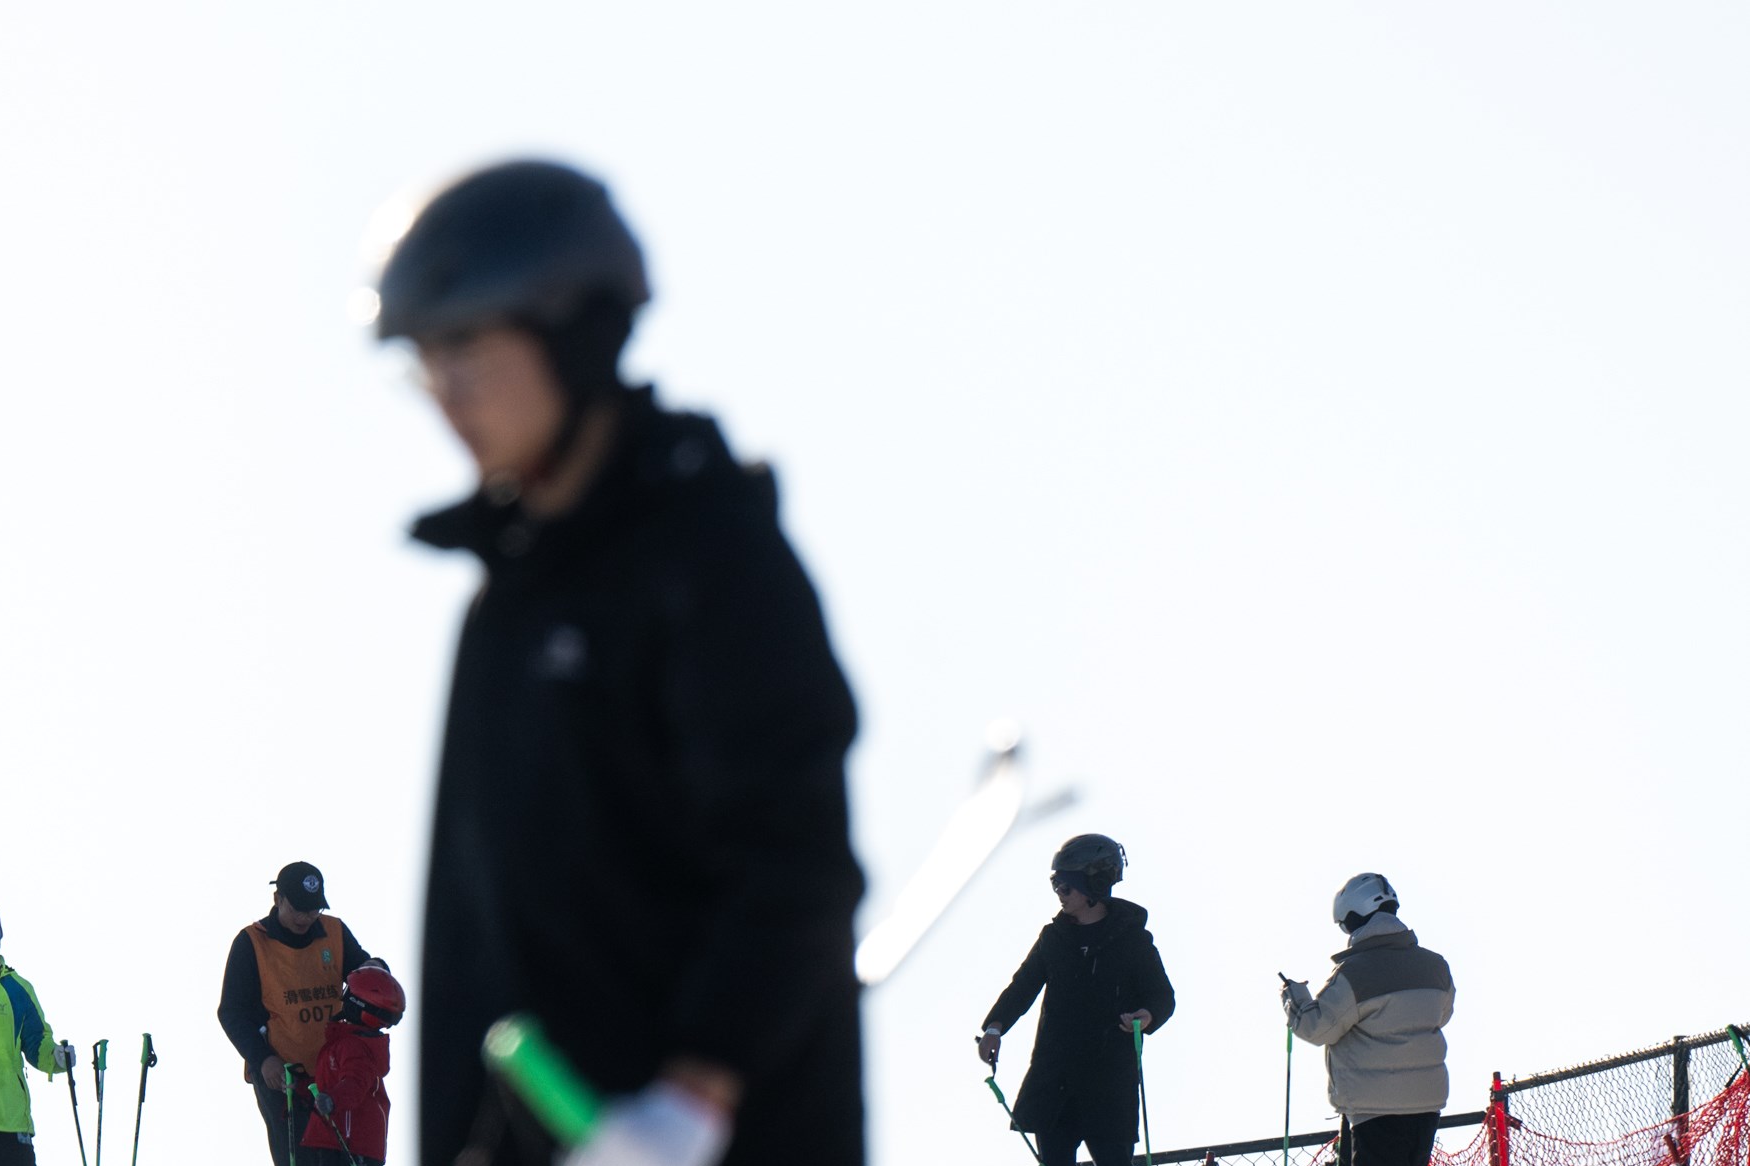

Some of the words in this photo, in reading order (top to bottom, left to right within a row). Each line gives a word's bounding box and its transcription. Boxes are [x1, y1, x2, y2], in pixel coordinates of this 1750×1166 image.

[283, 984, 339, 1005] 滑雪教练
[299, 1004, 333, 1023] 007
